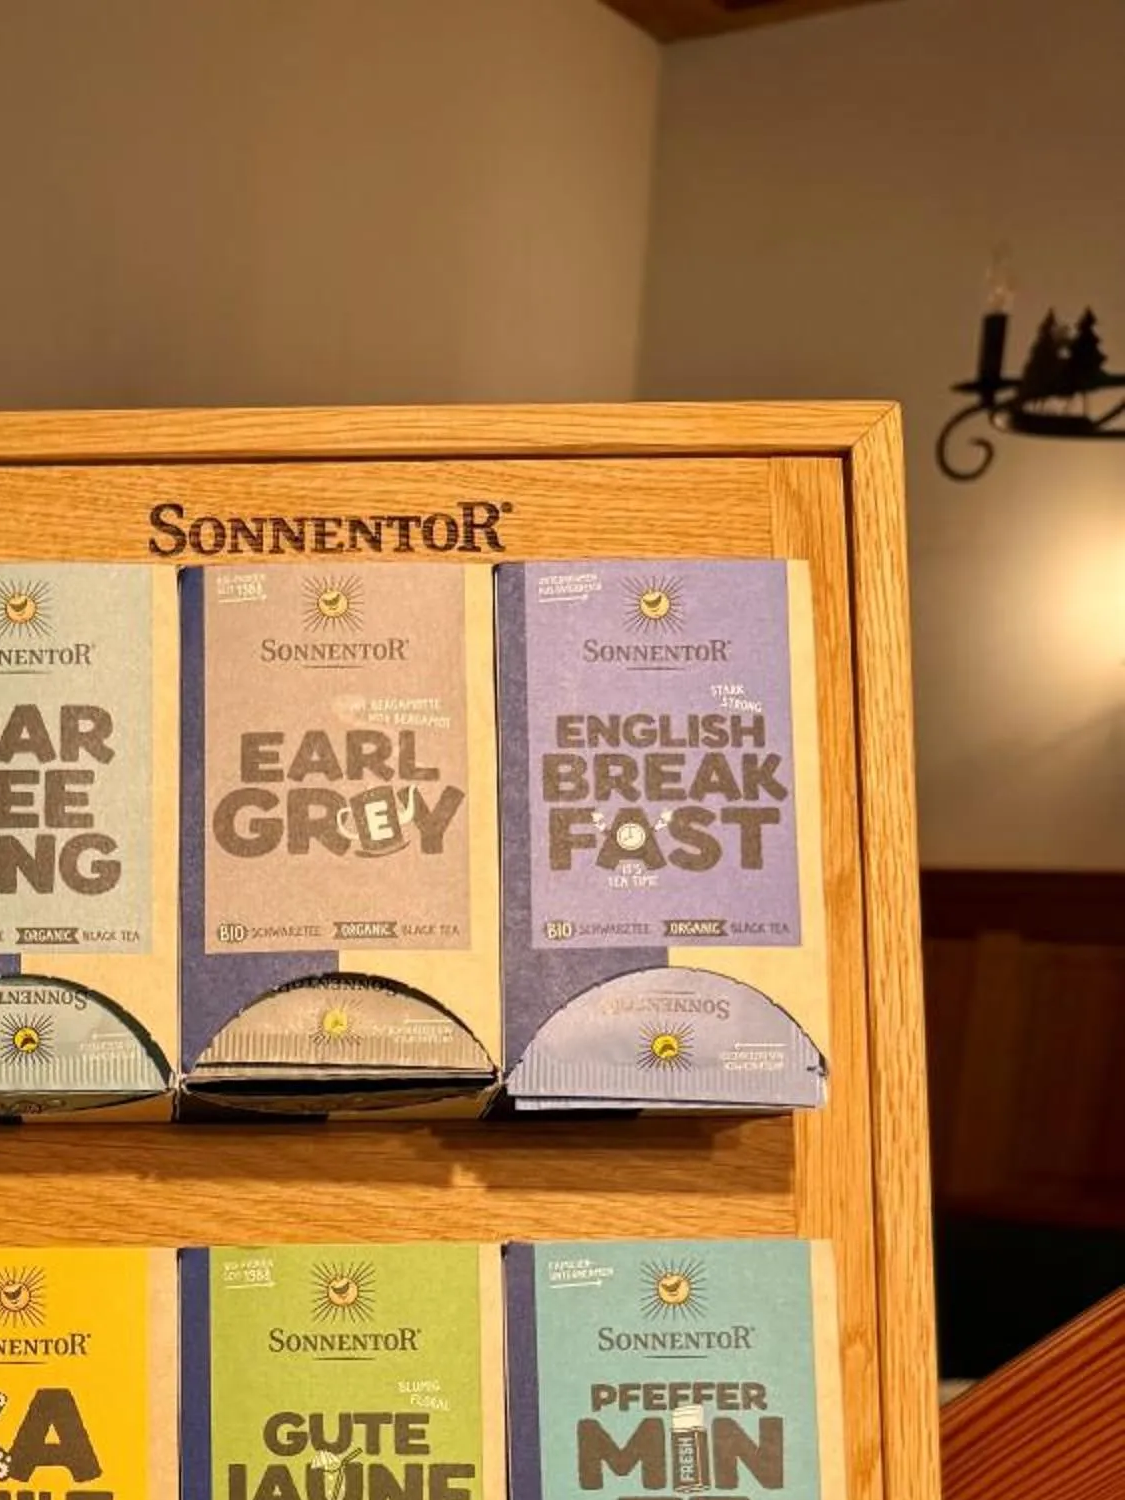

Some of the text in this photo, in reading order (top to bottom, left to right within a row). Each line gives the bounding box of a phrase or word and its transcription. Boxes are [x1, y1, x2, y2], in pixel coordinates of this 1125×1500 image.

[149, 502, 507, 556] SONNENTOR
[260, 638, 407, 662] SONNENTOR
[583, 639, 728, 663] SONNENTOR
[722, 698, 762, 712] STRONG
[556, 714, 766, 749] ENGLISH
[240, 730, 440, 783] EARL
[542, 753, 788, 801] BREAK
[212, 785, 465, 858] GREY
[548, 806, 780, 871] FAST
[23, 928, 73, 944] ORGANIC
[121, 930, 140, 942] TEA
[217, 923, 245, 942] BIO
[340, 923, 391, 937] ORGANIC
[439, 925, 459, 937] TEA
[546, 921, 573, 940] BIO
[669, 920, 722, 935] ORGANIC
[770, 923, 789, 935] TEA
[269, 1328, 418, 1352] SONNENTOR
[598, 1326, 751, 1351] SONNENTOR
[591, 1382, 768, 1412] PFEFFER
[263, 1411, 431, 1457] GUTE
[679, 1437, 696, 1483] FRESH
